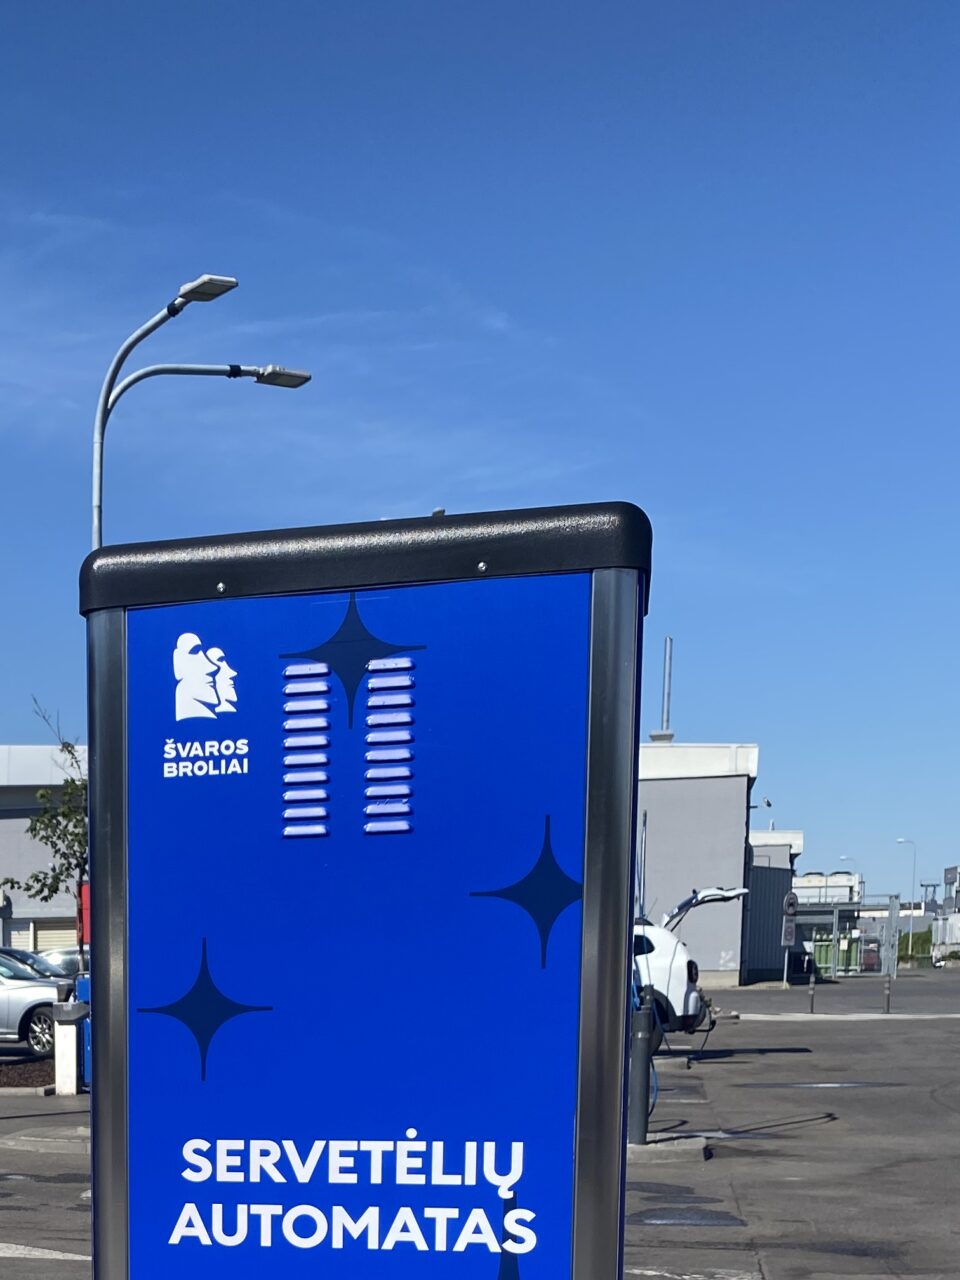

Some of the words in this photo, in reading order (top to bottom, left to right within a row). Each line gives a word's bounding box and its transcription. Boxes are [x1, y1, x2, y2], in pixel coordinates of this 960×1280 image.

[163, 738, 249, 759] ŠVAROS
[163, 758, 249, 778] BROLIAI
[181, 1127, 524, 1200] SERVETĖLIŲ
[167, 1202, 537, 1254] AUTOMATAS
